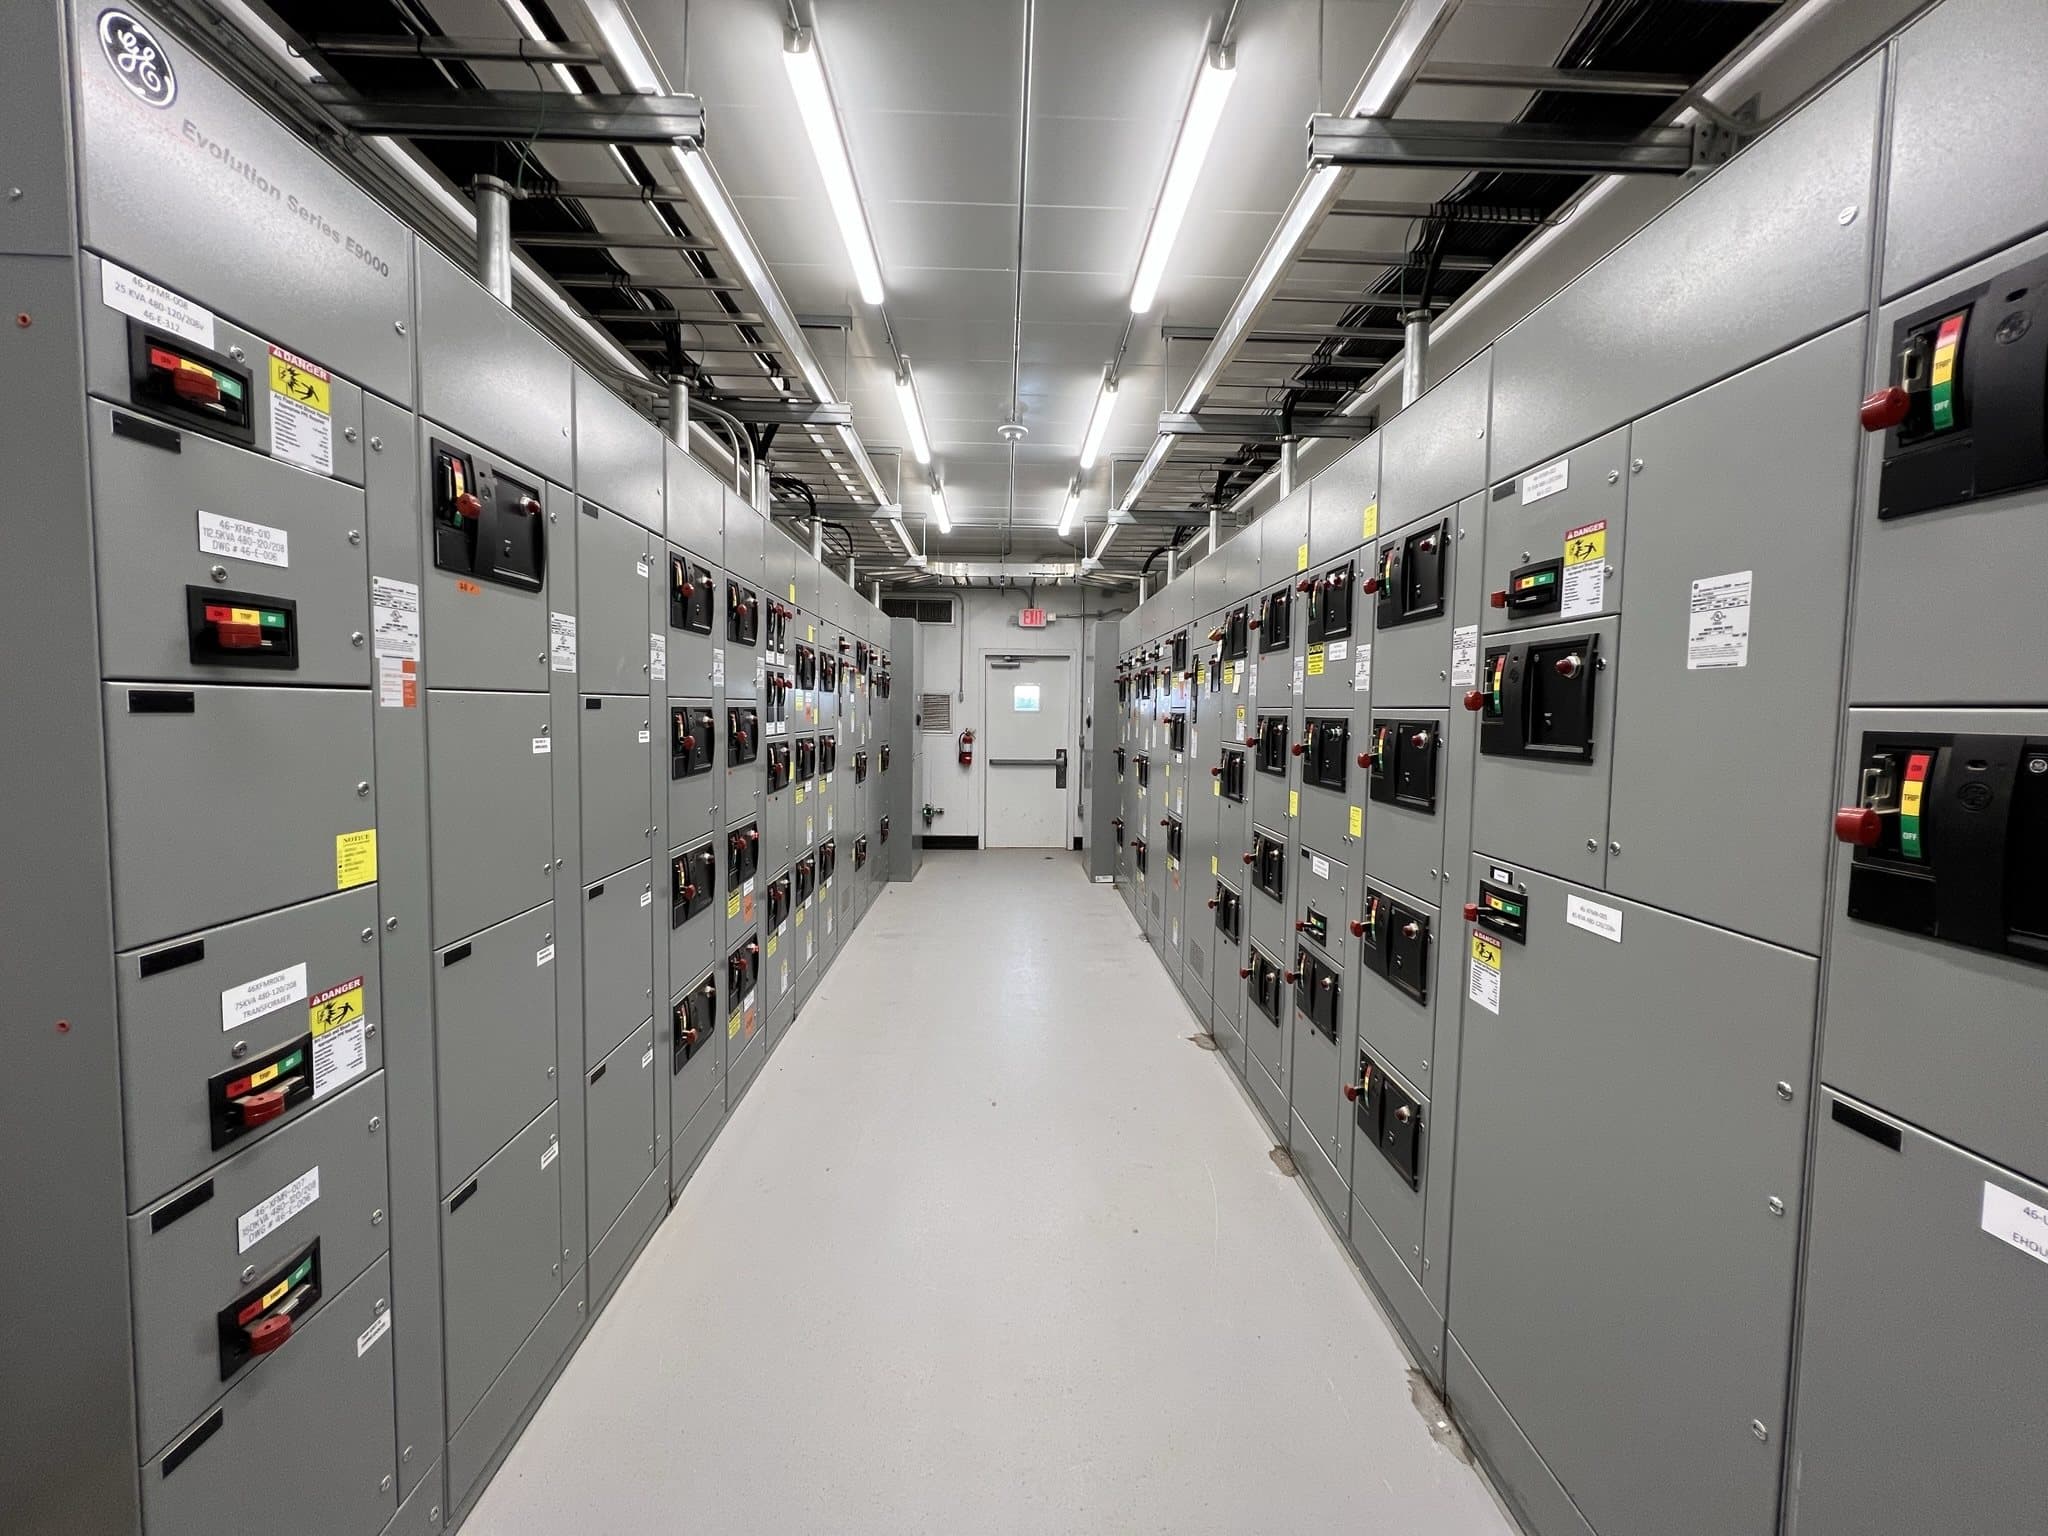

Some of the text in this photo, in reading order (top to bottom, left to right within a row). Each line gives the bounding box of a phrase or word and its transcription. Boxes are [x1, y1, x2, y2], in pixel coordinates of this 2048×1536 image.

[182, 118, 390, 278] Evolution Series E9000
[115, 282, 128, 294] 25
[128, 288, 147, 304] KVA
[283, 352, 328, 381] DANGER
[1934, 400, 1949, 411] OFF
[1574, 521, 1605, 538] DANGER
[212, 540, 231, 553] DWG
[1024, 610, 1043, 624] EXIT
[1904, 793, 1919, 801] TRIP
[1902, 832, 1918, 840] OFF
[322, 979, 361, 1002] DANGER
[243, 994, 291, 1019] TRANSFORMER
